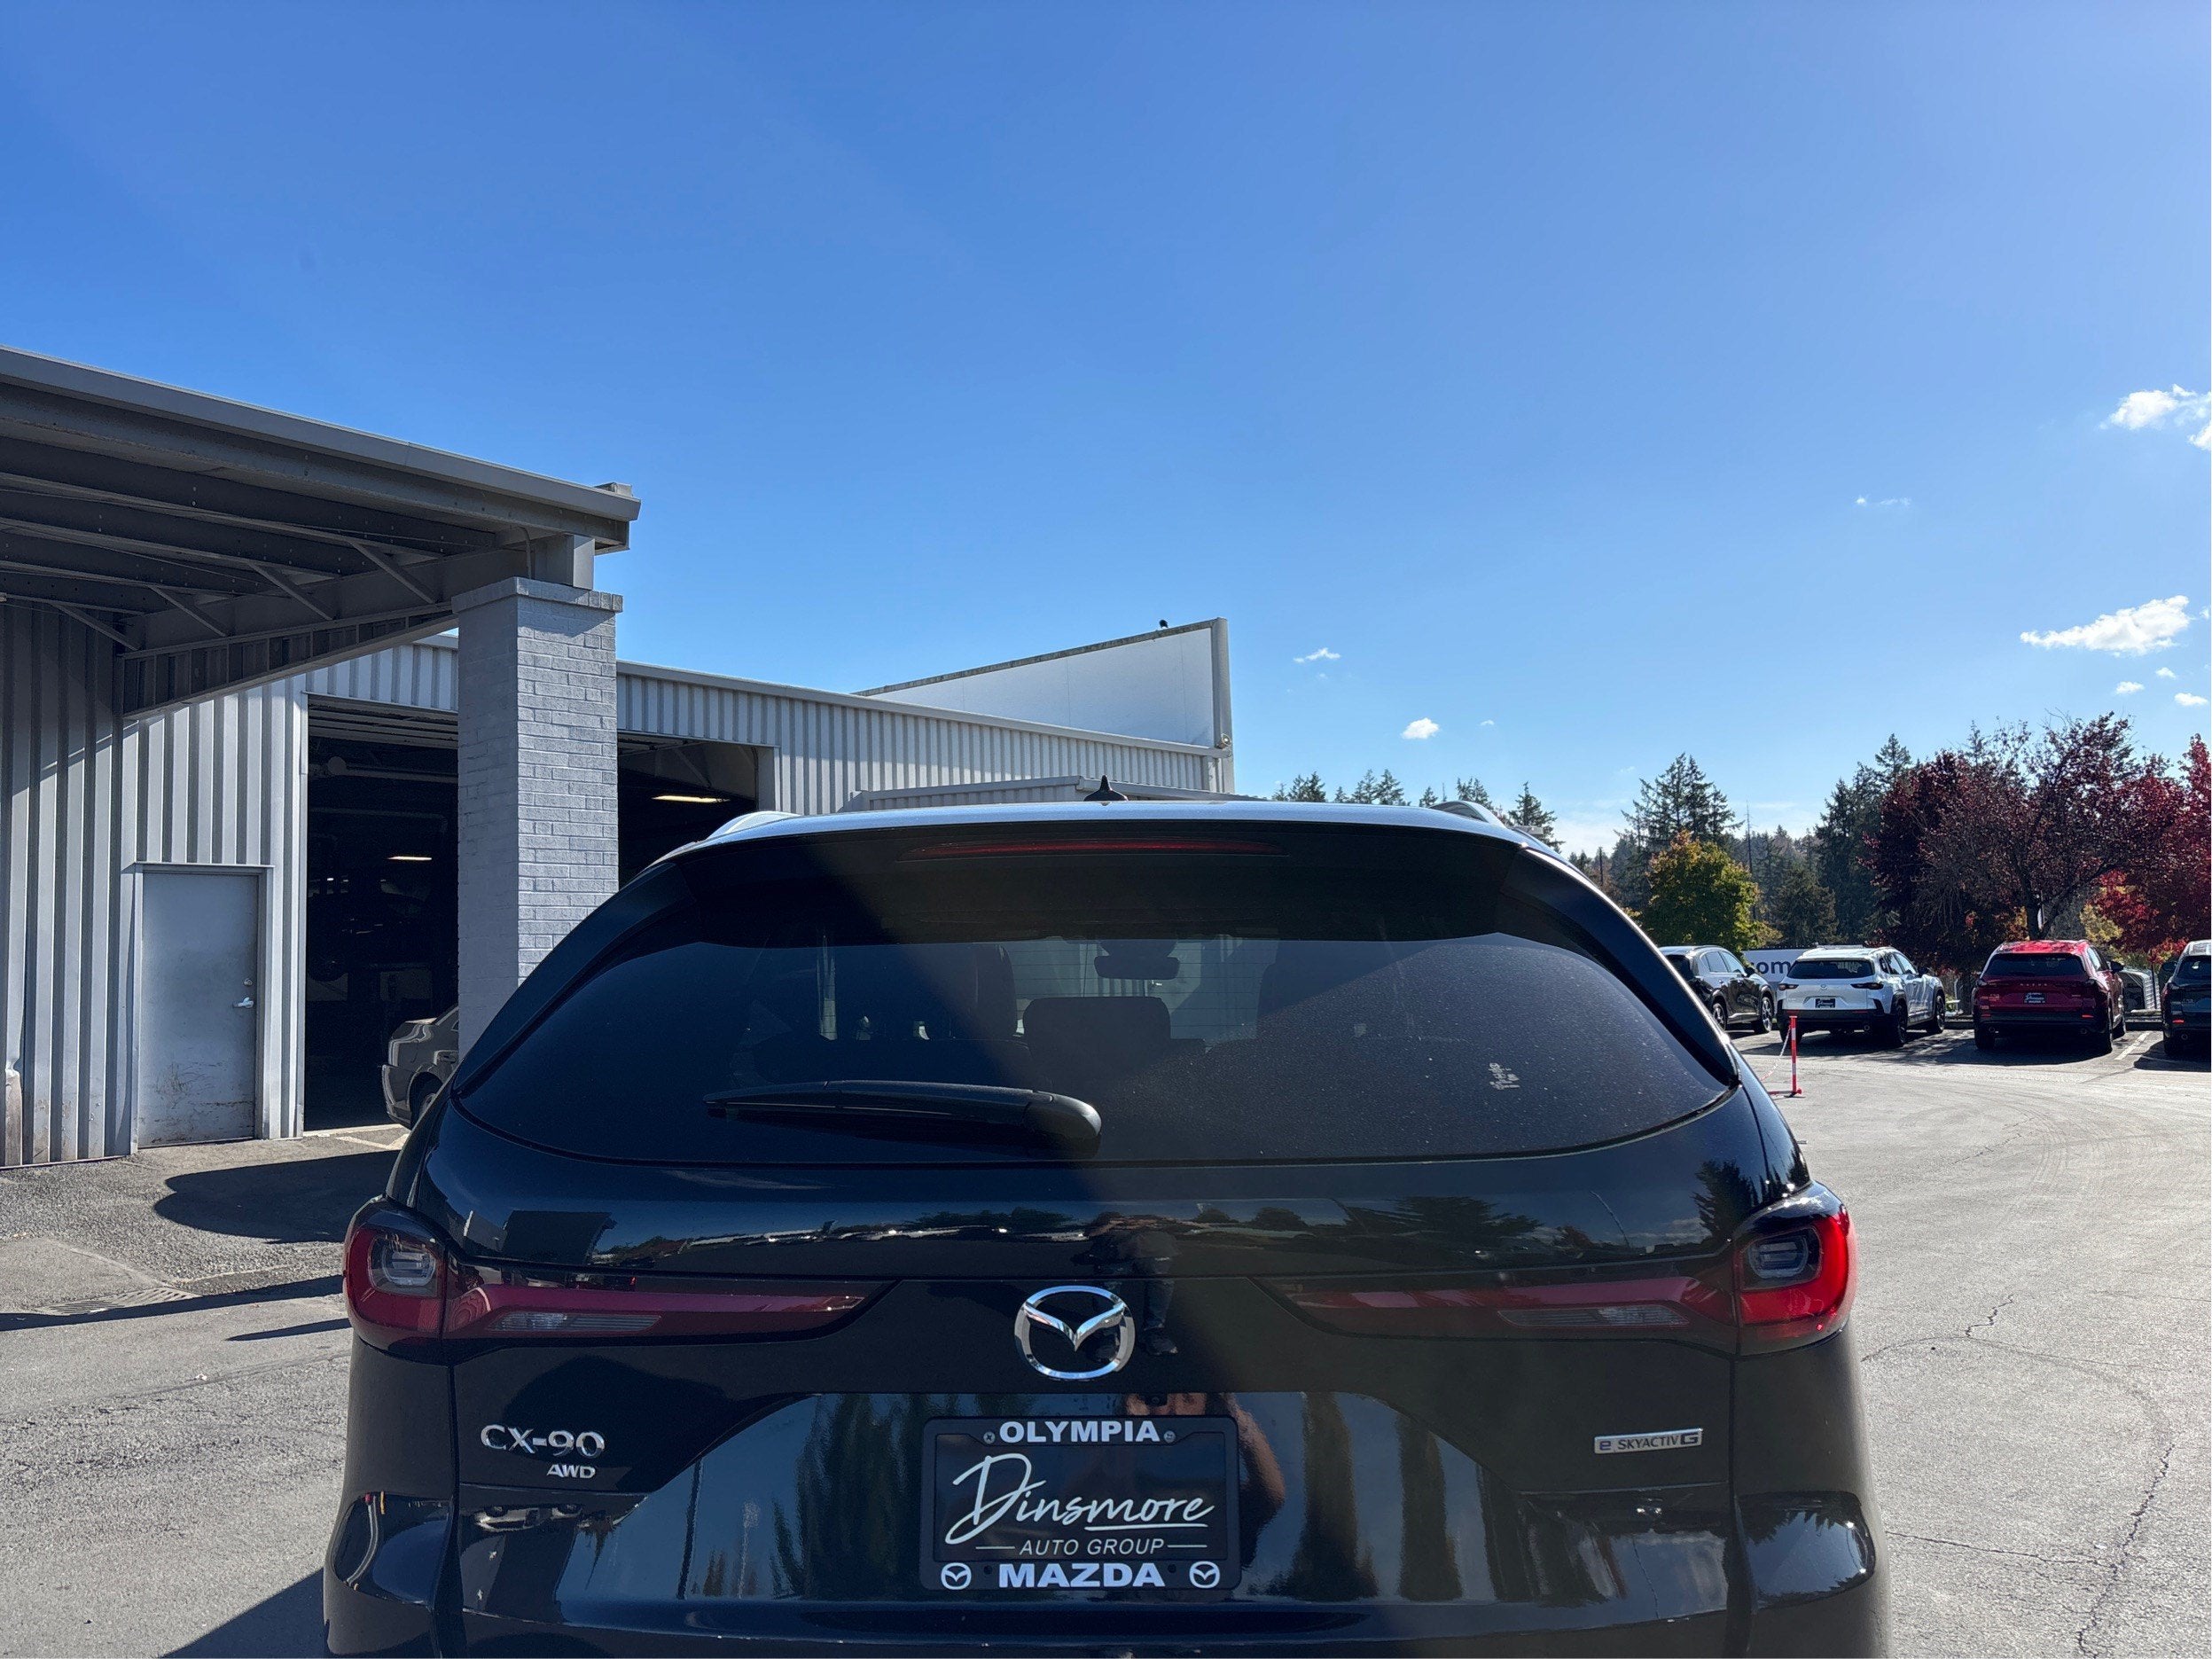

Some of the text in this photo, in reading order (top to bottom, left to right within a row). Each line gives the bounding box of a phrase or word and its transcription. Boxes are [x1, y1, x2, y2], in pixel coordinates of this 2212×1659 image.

[1751, 961, 1791, 974] om
[481, 1424, 606, 1458] CX-90
[999, 1420, 1161, 1444] OLYMPIA
[547, 1464, 596, 1479] AWD
[945, 1452, 1215, 1545] Dinsmore
[1019, 1538, 1164, 1556] AUTO GROUP
[998, 1563, 1166, 1589] MAZDA
